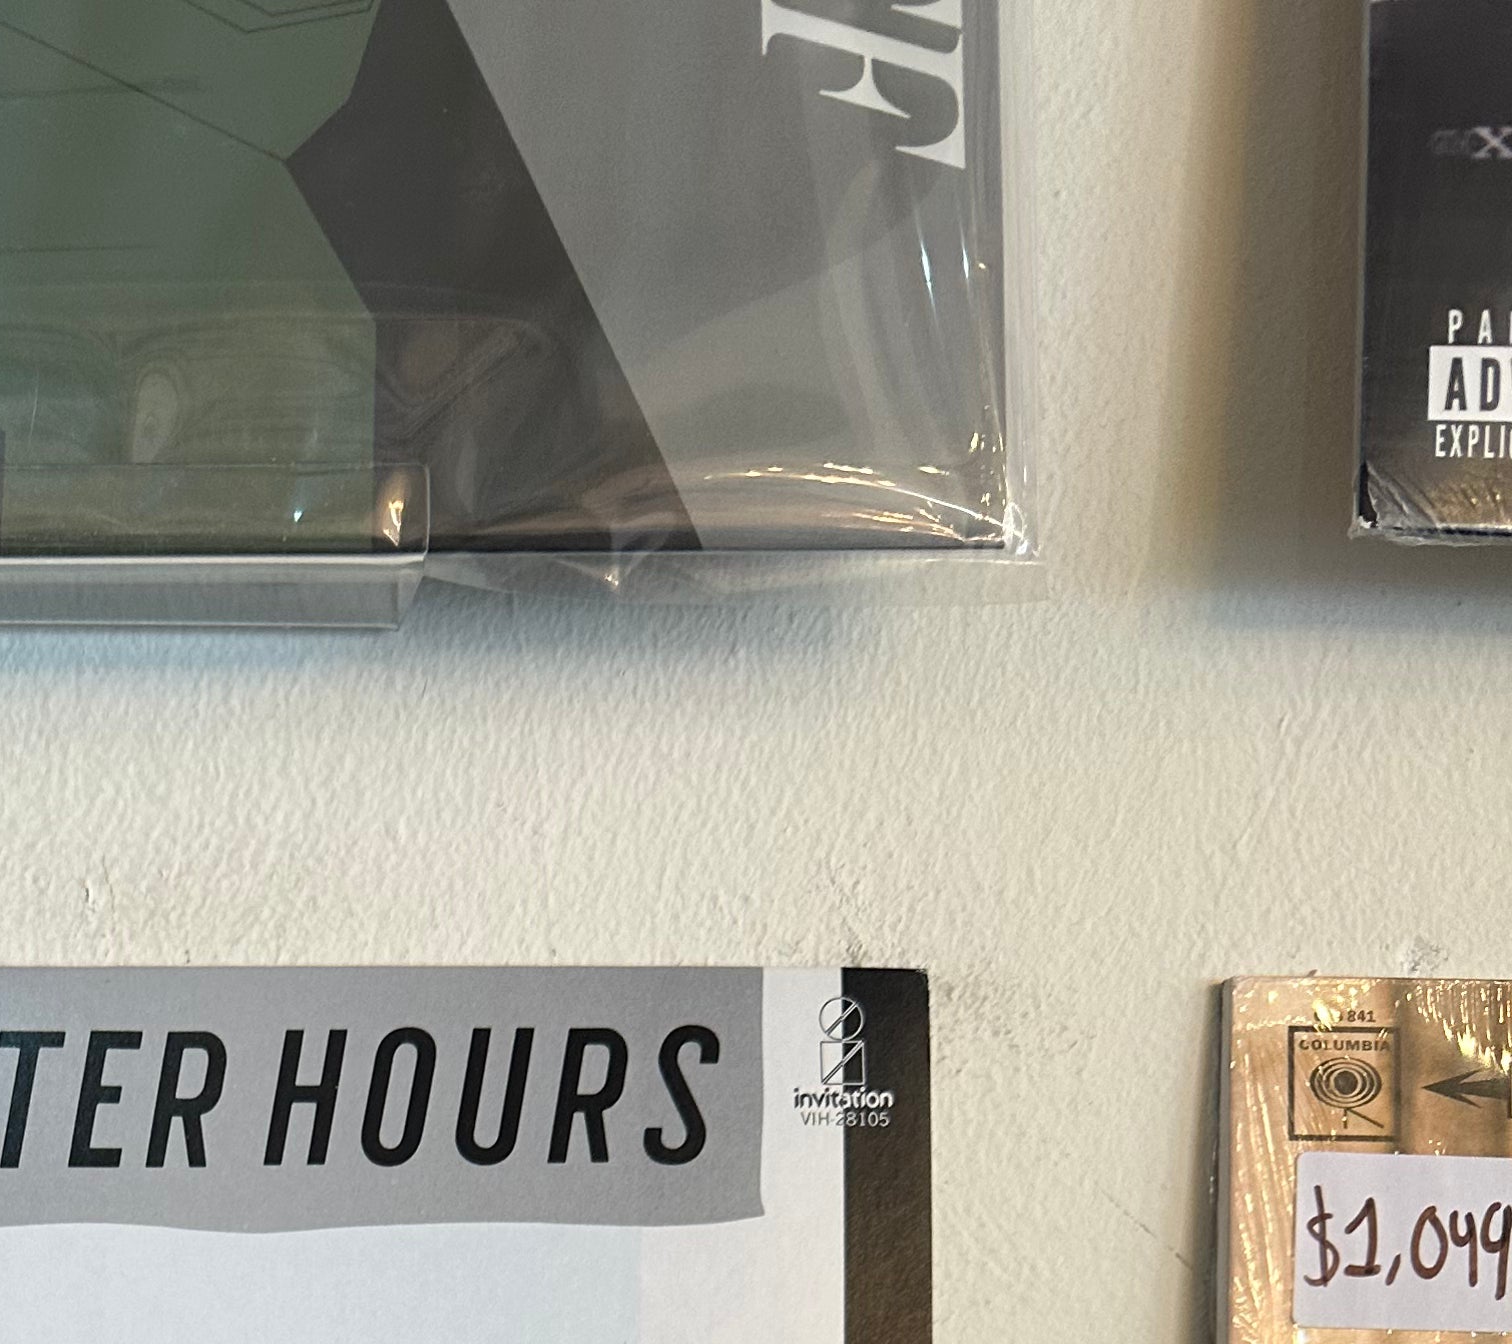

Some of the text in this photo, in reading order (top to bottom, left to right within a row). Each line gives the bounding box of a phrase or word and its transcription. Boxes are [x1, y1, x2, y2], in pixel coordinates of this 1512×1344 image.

[1447, 309, 1512, 345] PA
[1444, 357, 1512, 412] AD
[1299, 1039, 1389, 1051] COLUMBIA
[264, 1024, 721, 1168] HOURS
[793, 1087, 894, 1109] invitation
